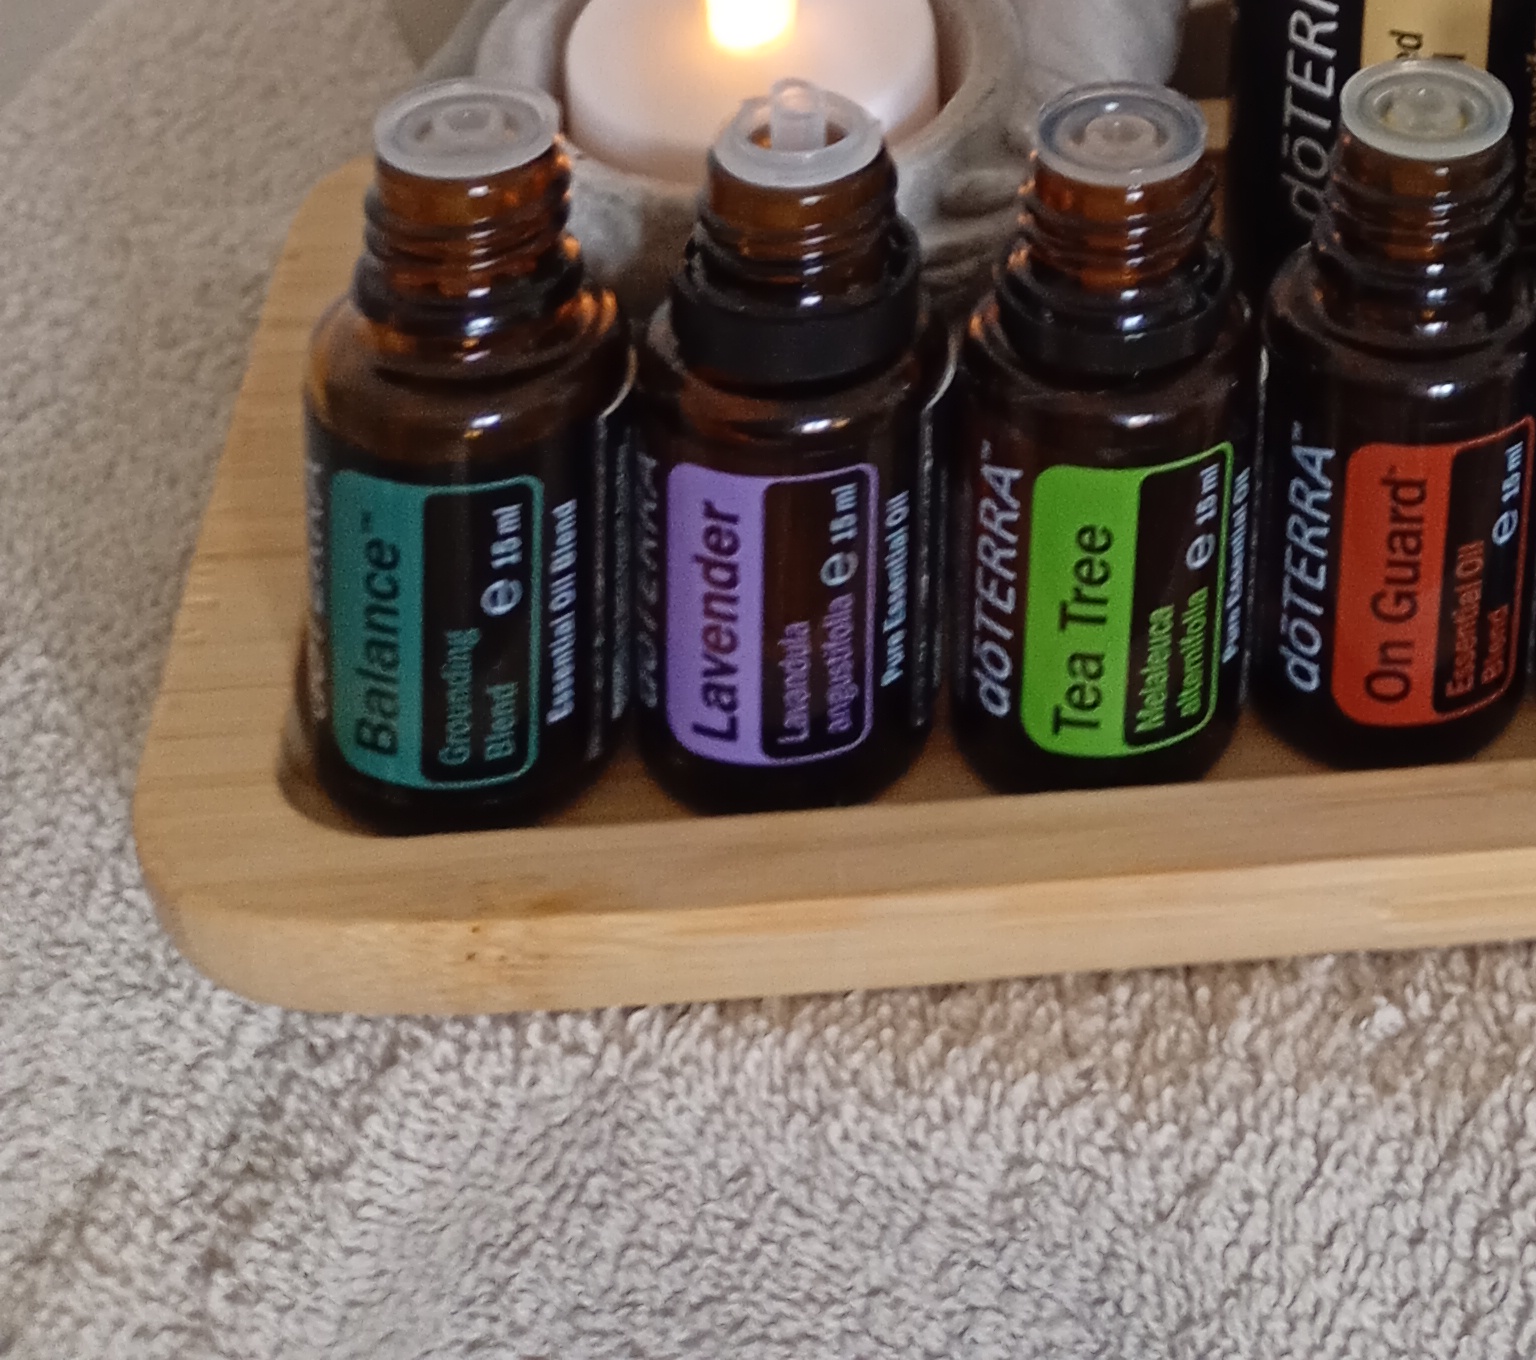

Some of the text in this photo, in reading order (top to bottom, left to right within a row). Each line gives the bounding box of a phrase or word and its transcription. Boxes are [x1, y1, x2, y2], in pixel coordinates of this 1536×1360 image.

[831, 483, 857, 512] ml
[1200, 463, 1220, 494] ml
[1504, 441, 1524, 471] ml
[490, 536, 522, 569] 15
[492, 504, 522, 534] ml
[830, 513, 857, 545] 15
[1196, 495, 1218, 526] 15
[547, 499, 577, 725] Essential Oil Blend
[690, 499, 740, 742] Lavender
[881, 490, 910, 687] Pure Essential Oil
[1053, 525, 1113, 736] Tea Tree
[1446, 540, 1485, 698] Essential Oil
[777, 621, 811, 744] Lavandula
[822, 592, 859, 734] angustifolia
[1134, 605, 1175, 733] Melaleuca
[1177, 586, 1209, 718] alternifolia
[1364, 638, 1415, 704] On
[1481, 604, 1509, 684] Blend
[438, 629, 481, 765] Grounding
[484, 682, 519, 761] Blend
